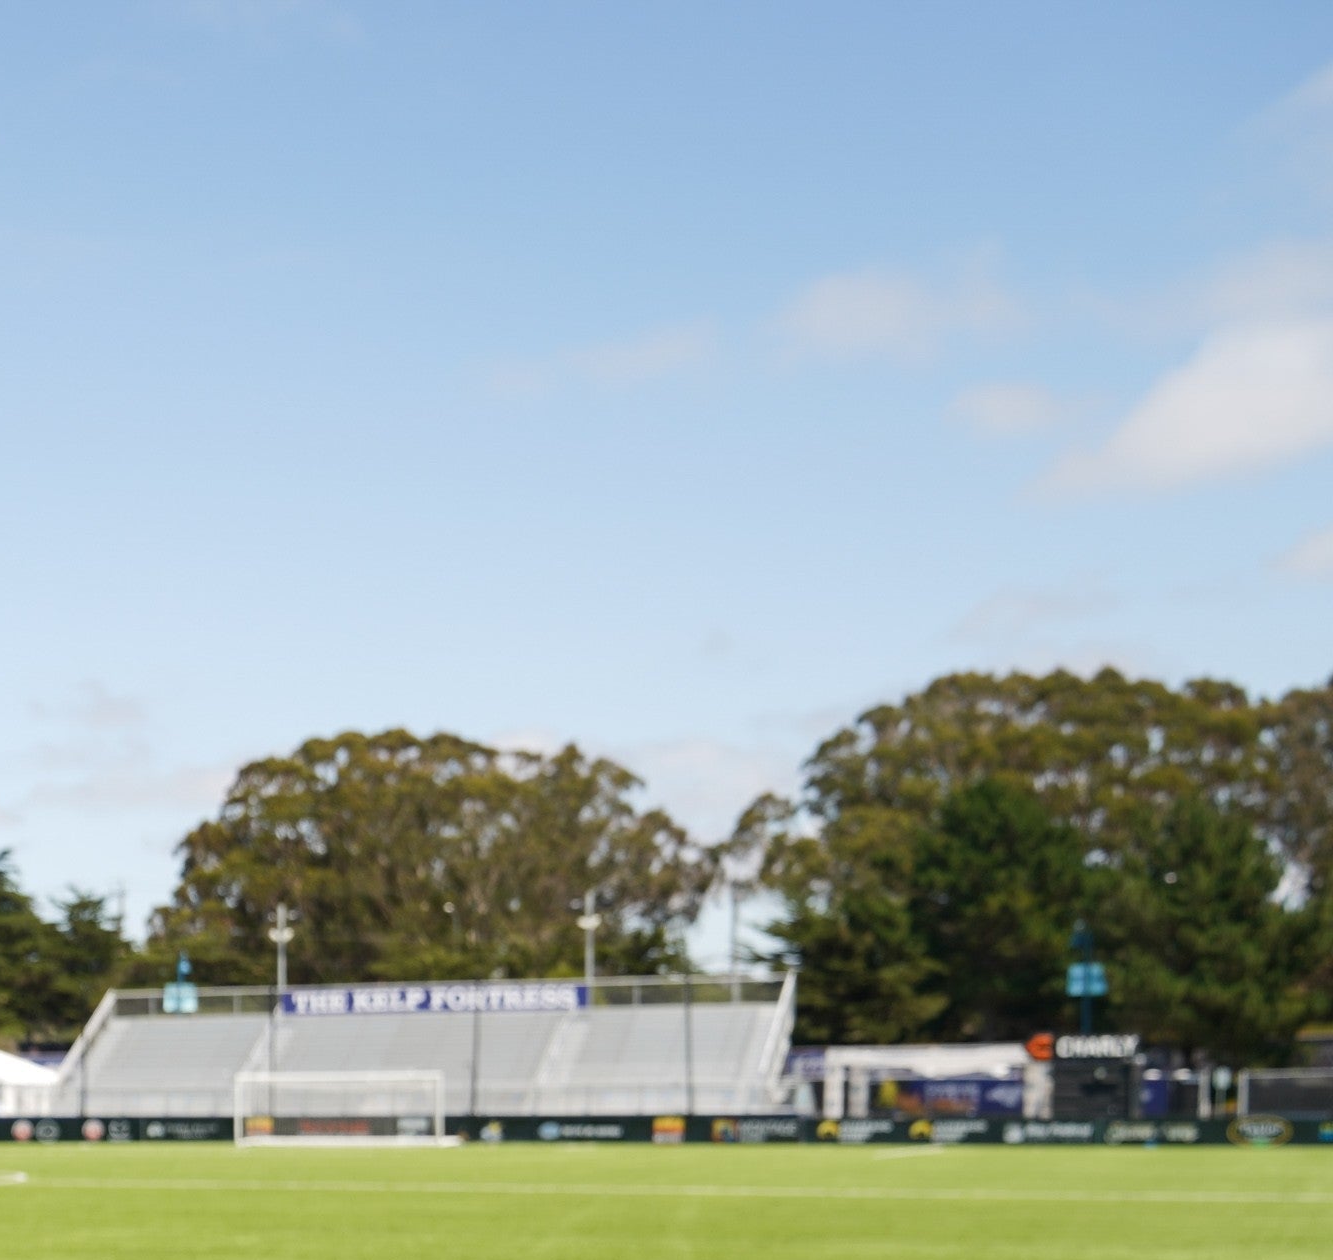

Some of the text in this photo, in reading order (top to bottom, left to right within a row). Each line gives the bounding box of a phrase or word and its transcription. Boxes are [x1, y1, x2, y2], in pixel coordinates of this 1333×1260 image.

[290, 983, 578, 1014] THE KELP FORTRESS
[1056, 1035, 1139, 1058] CHARLY
